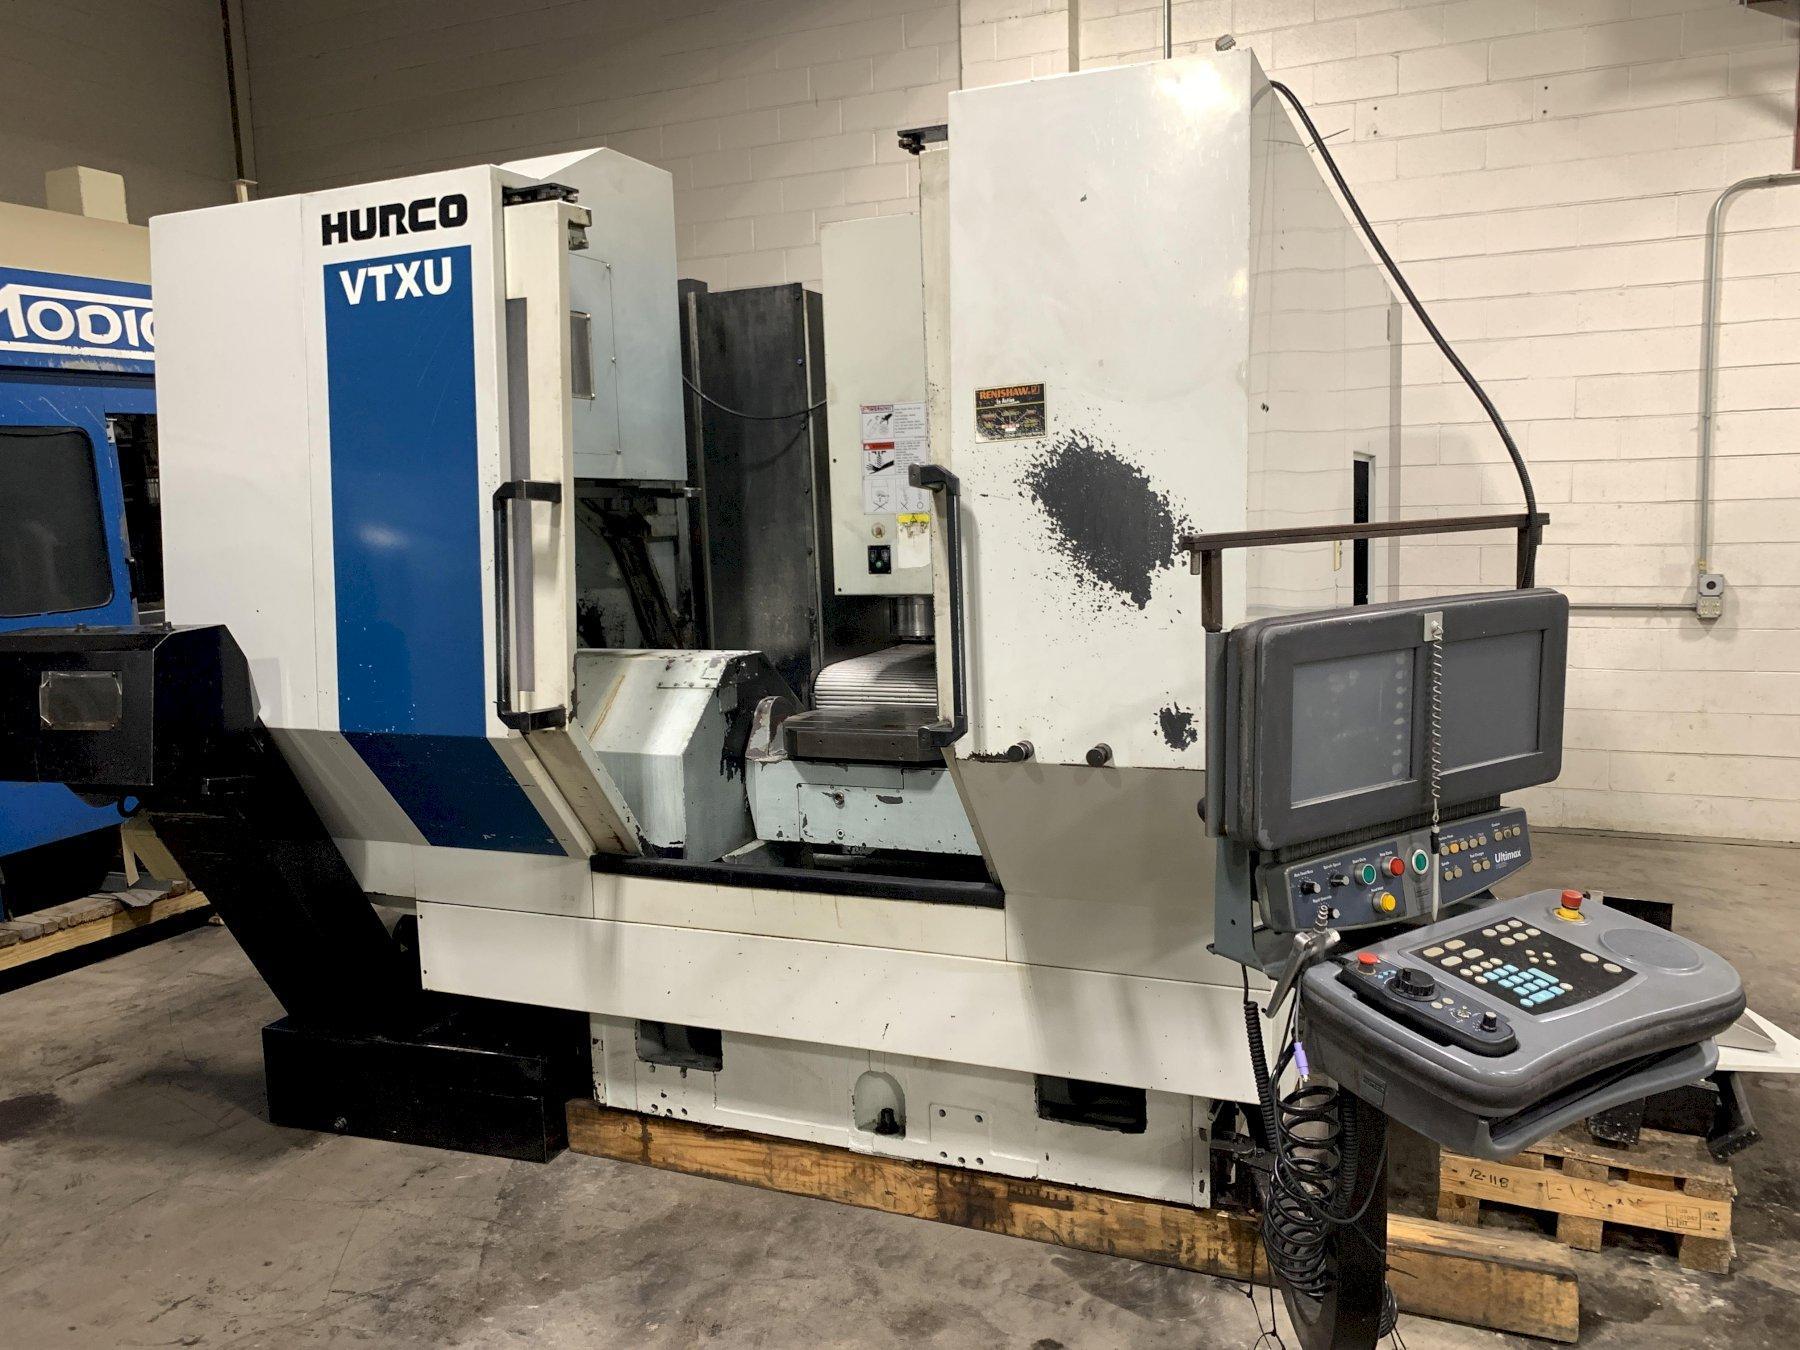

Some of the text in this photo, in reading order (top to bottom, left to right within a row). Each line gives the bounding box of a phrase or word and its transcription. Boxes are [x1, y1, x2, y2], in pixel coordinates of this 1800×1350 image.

[321, 194, 468, 246] HURCO
[339, 256, 453, 306] VTXU
[979, 387, 1028, 399] RENISHAW
[1494, 849, 1522, 863] Ultimax
